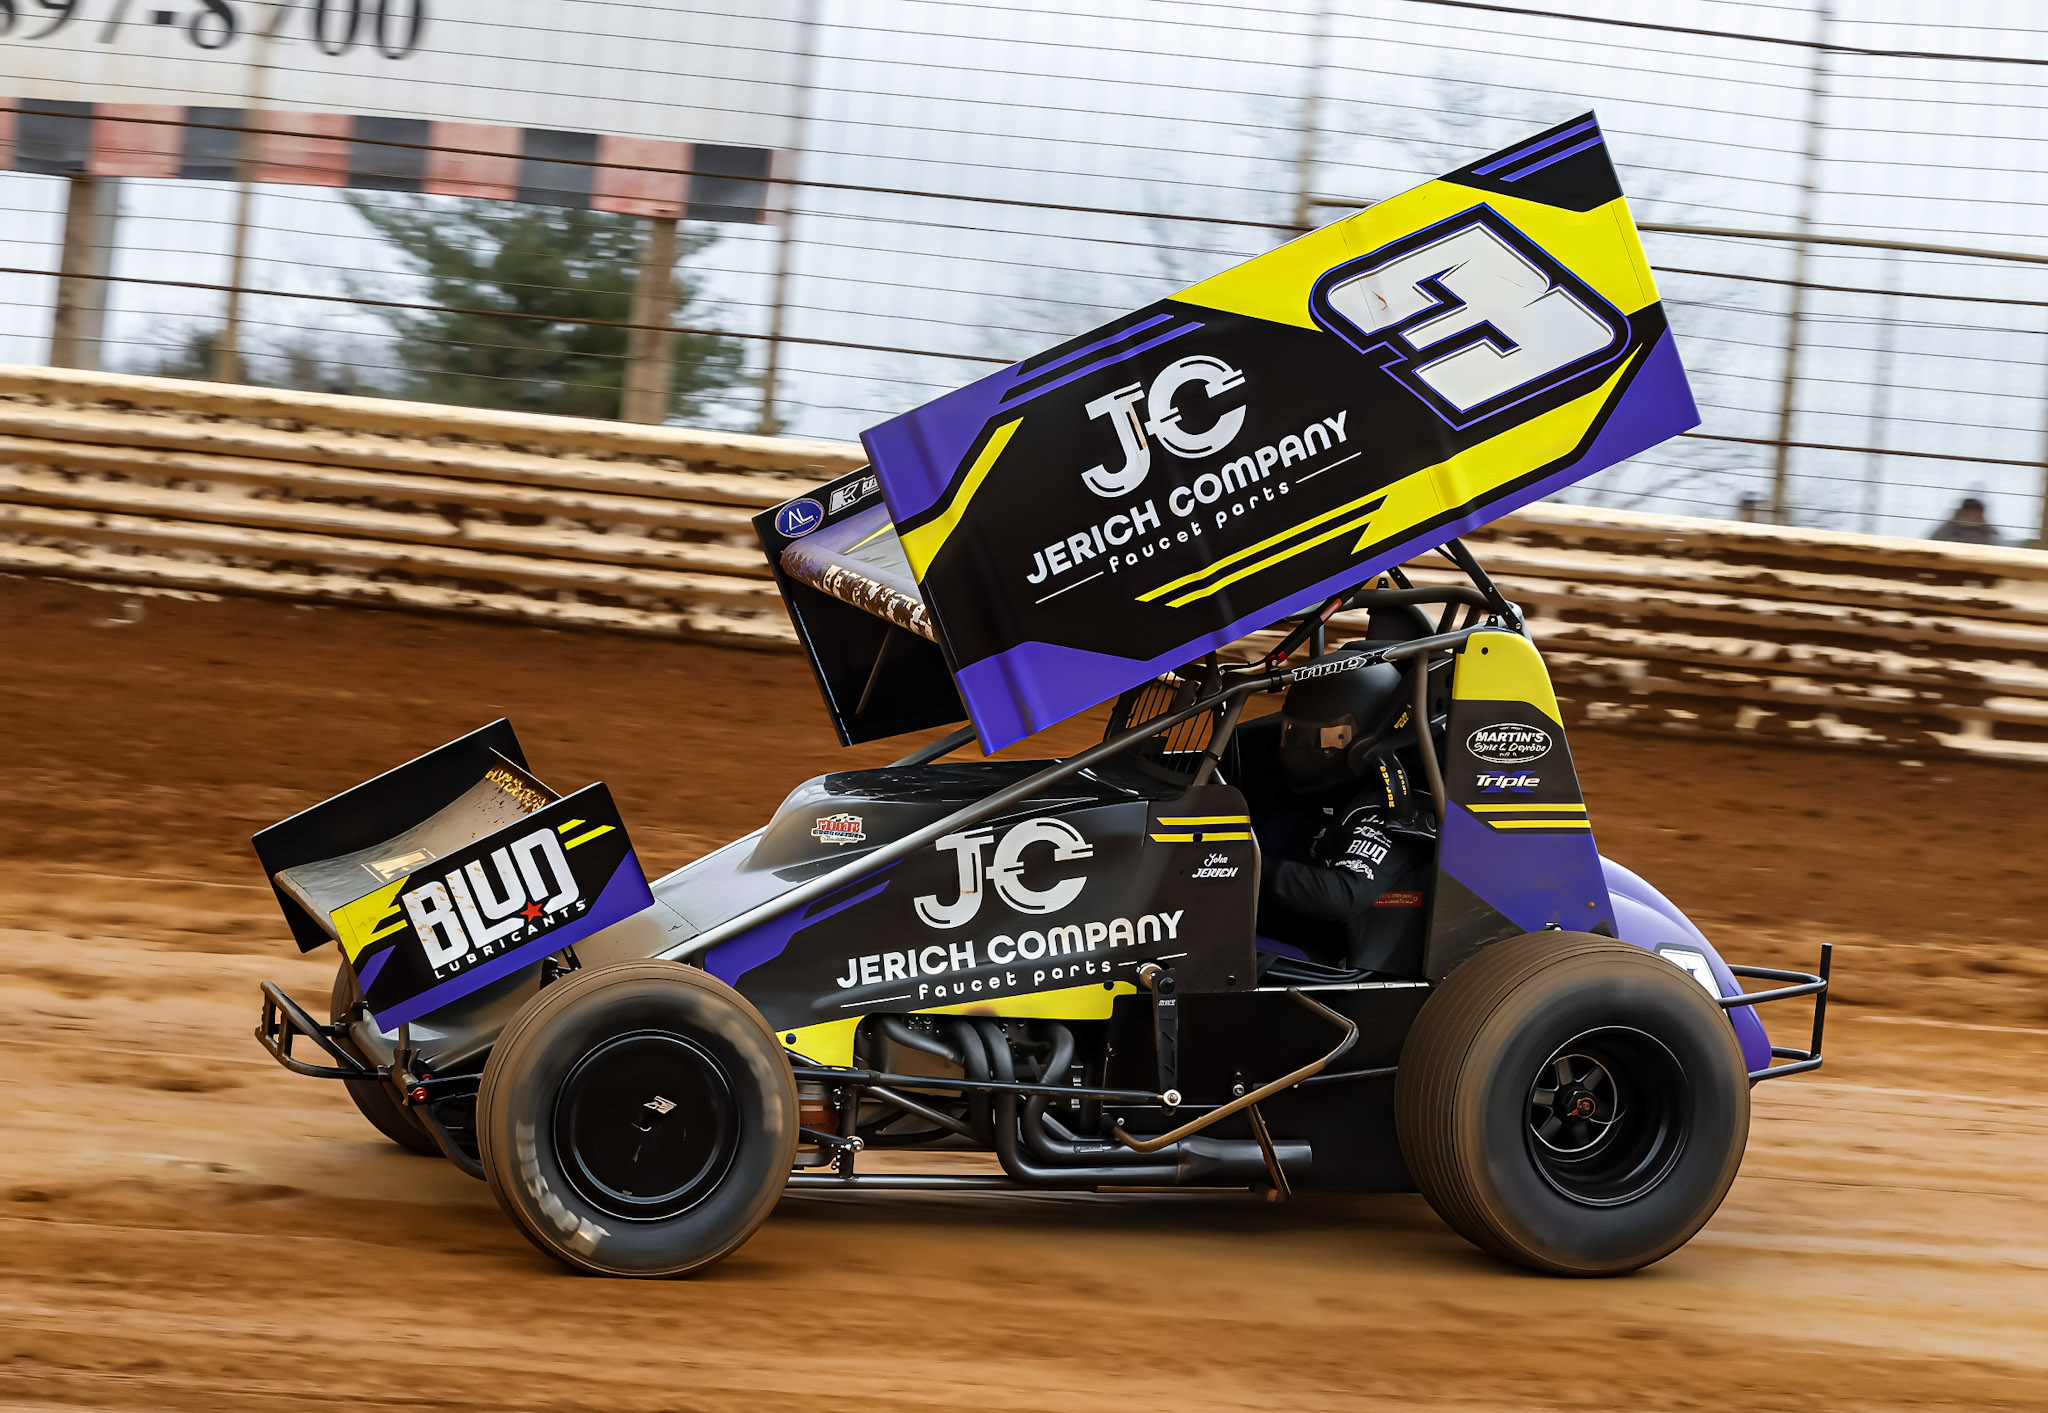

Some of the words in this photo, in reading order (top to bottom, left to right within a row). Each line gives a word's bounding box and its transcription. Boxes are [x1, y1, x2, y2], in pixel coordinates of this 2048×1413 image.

[1325, 220, 1615, 415] 3
[1026, 499, 1162, 585] JERICH
[1168, 409, 1347, 518] COMPANY
[1108, 521, 1203, 574] faucet
[1214, 480, 1291, 529] parts
[1475, 731, 1545, 743] MARTIN'S
[1476, 774, 1541, 789] Triple
[402, 828, 580, 970] BLUD
[433, 899, 587, 980] LUBRICANTS
[836, 940, 979, 989] JERICH
[987, 910, 1185, 965] COMPANY
[918, 970, 1017, 1001] faucet
[1033, 958, 1112, 987] parts
